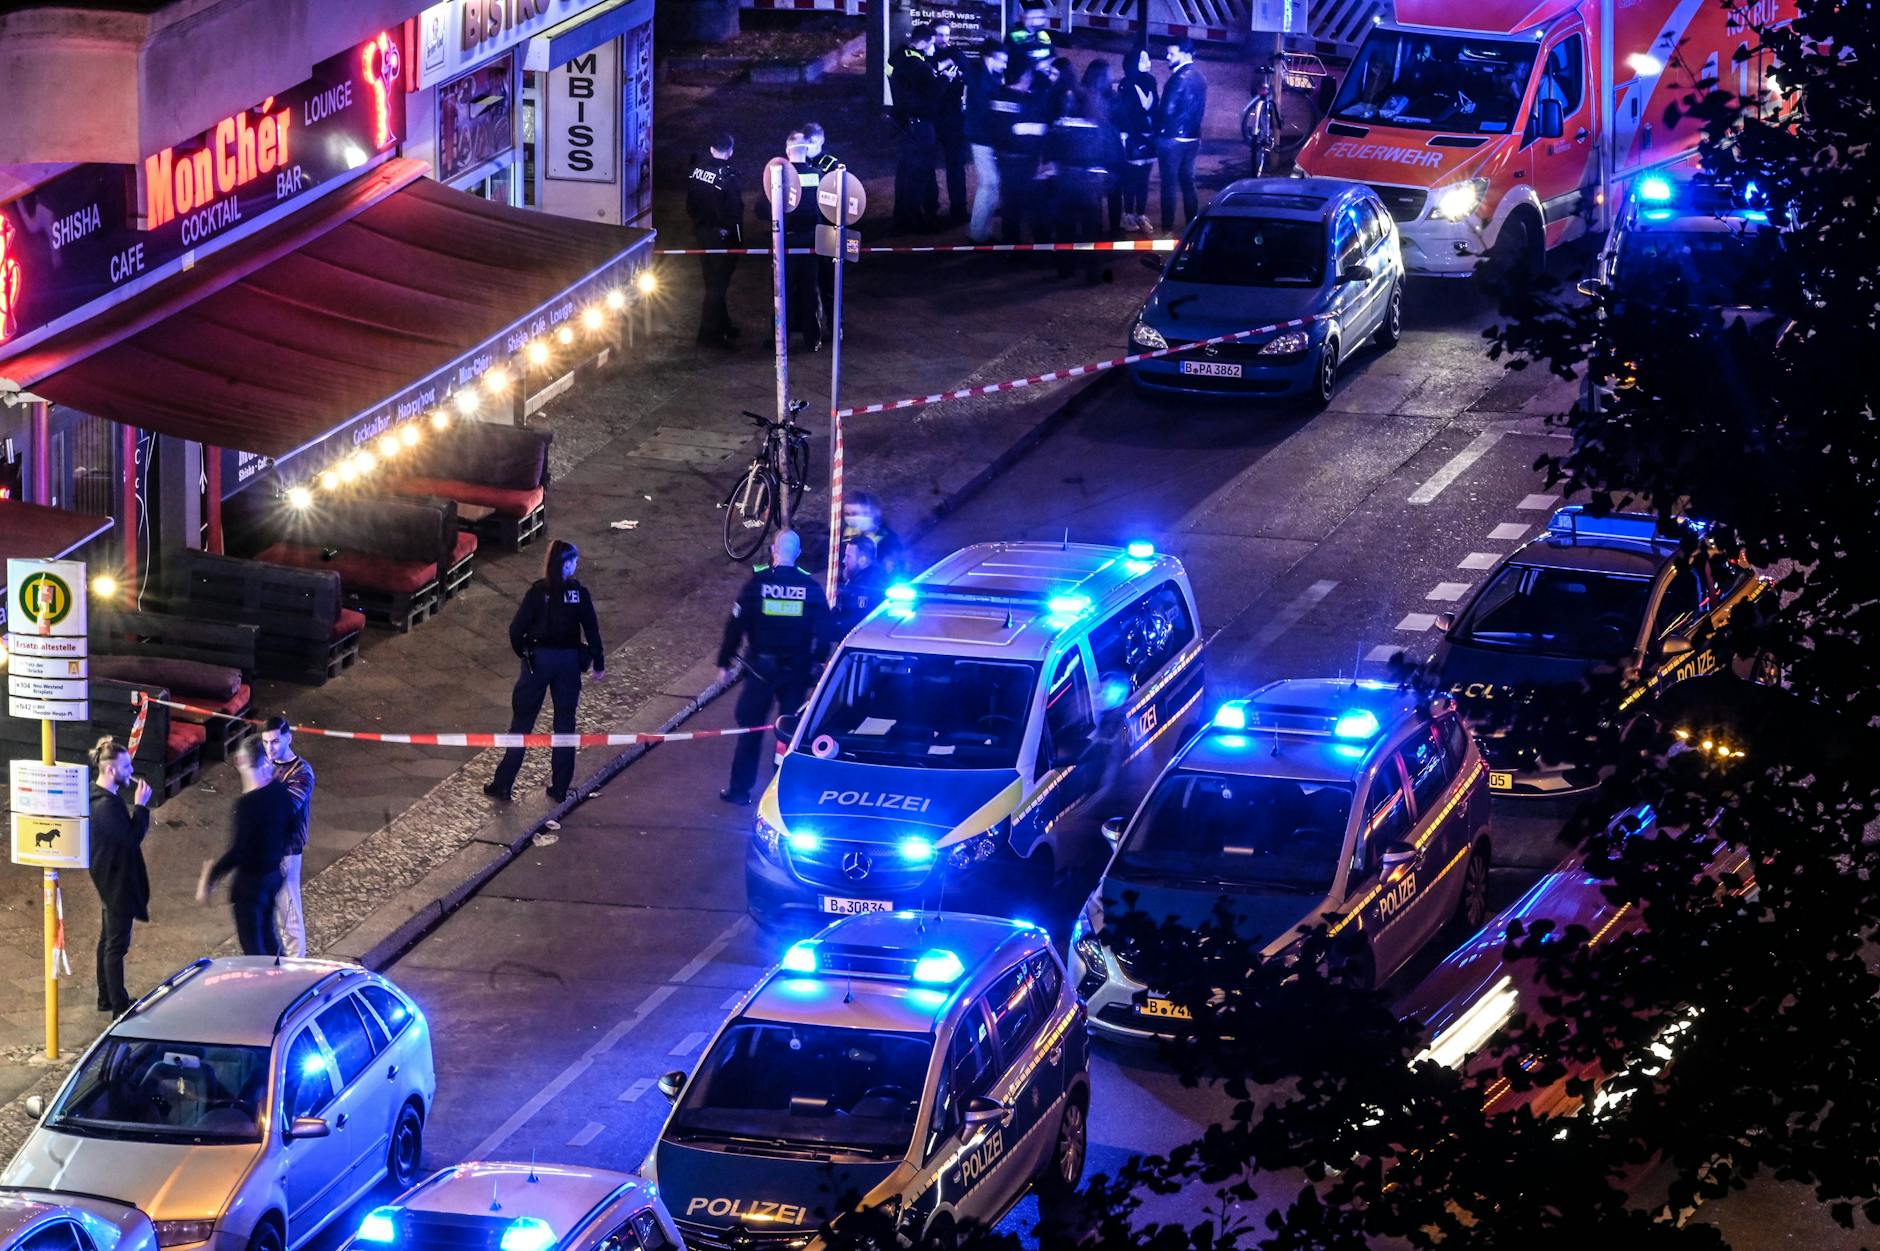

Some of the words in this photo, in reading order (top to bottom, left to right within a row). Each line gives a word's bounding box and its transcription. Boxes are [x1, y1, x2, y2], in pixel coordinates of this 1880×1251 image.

[461, 0, 550, 51] BIST
[910, 9, 920, 17] Es
[922, 9, 935, 18] tut
[949, 21, 980, 30] benan
[304, 80, 352, 126] LOUNGE
[566, 53, 597, 172] MBISS
[145, 147, 214, 231] Mon
[215, 95, 291, 193] Chér
[1324, 141, 1443, 168] FEUERWEHR
[692, 167, 717, 185] POLIZEI
[181, 195, 242, 247] COCKTAIL
[276, 165, 302, 200] BAR
[52, 203, 101, 250] SHISHA
[110, 242, 145, 283] CAFE
[1185, 362, 1192, 373] B
[761, 583, 807, 600] POLIZEI
[16, 640, 76, 652] Ersatzaltestelle
[818, 790, 931, 813] POLIZEI
[1380, 872, 1416, 922] POLIZEI
[962, 1129, 1004, 1187] POLIZEI
[686, 1197, 806, 1226] POLIZEI
